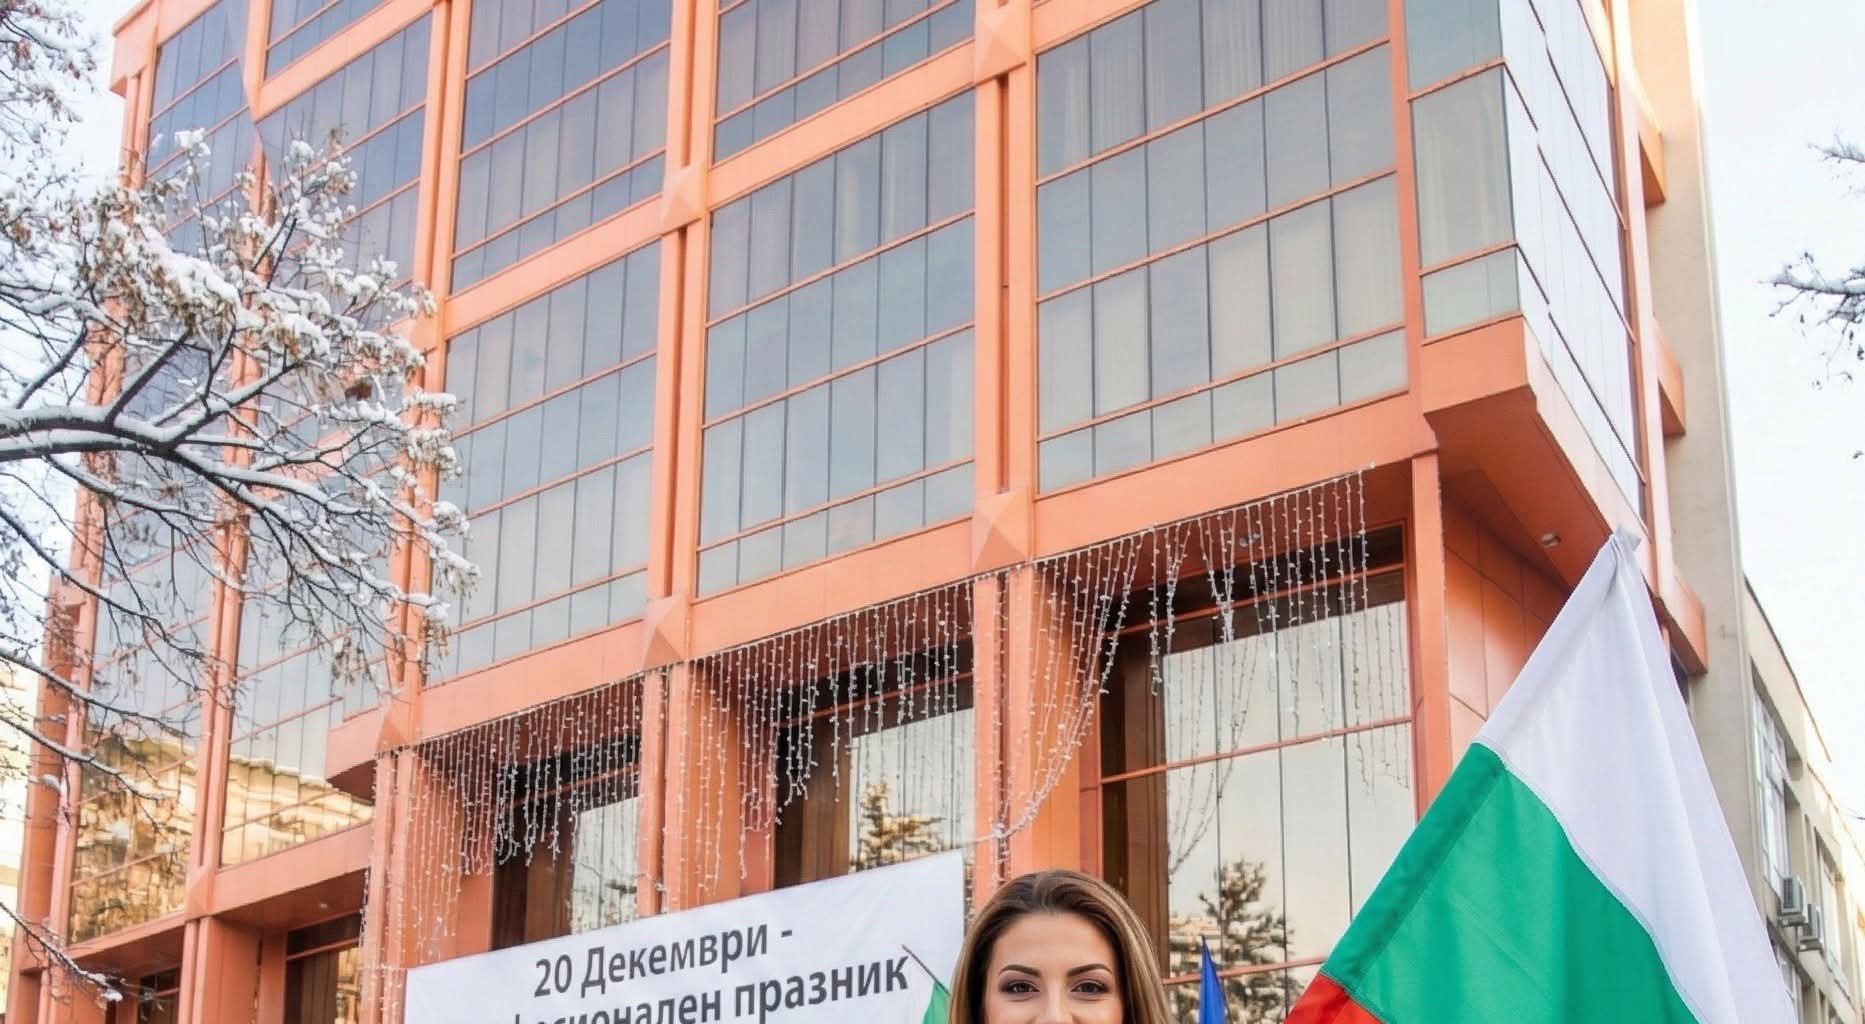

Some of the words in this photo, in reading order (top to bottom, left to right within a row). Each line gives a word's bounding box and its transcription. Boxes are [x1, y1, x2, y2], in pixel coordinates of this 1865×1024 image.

[534, 954, 572, 998] 20
[580, 924, 767, 999] Декември
[735, 955, 909, 1024] празник
